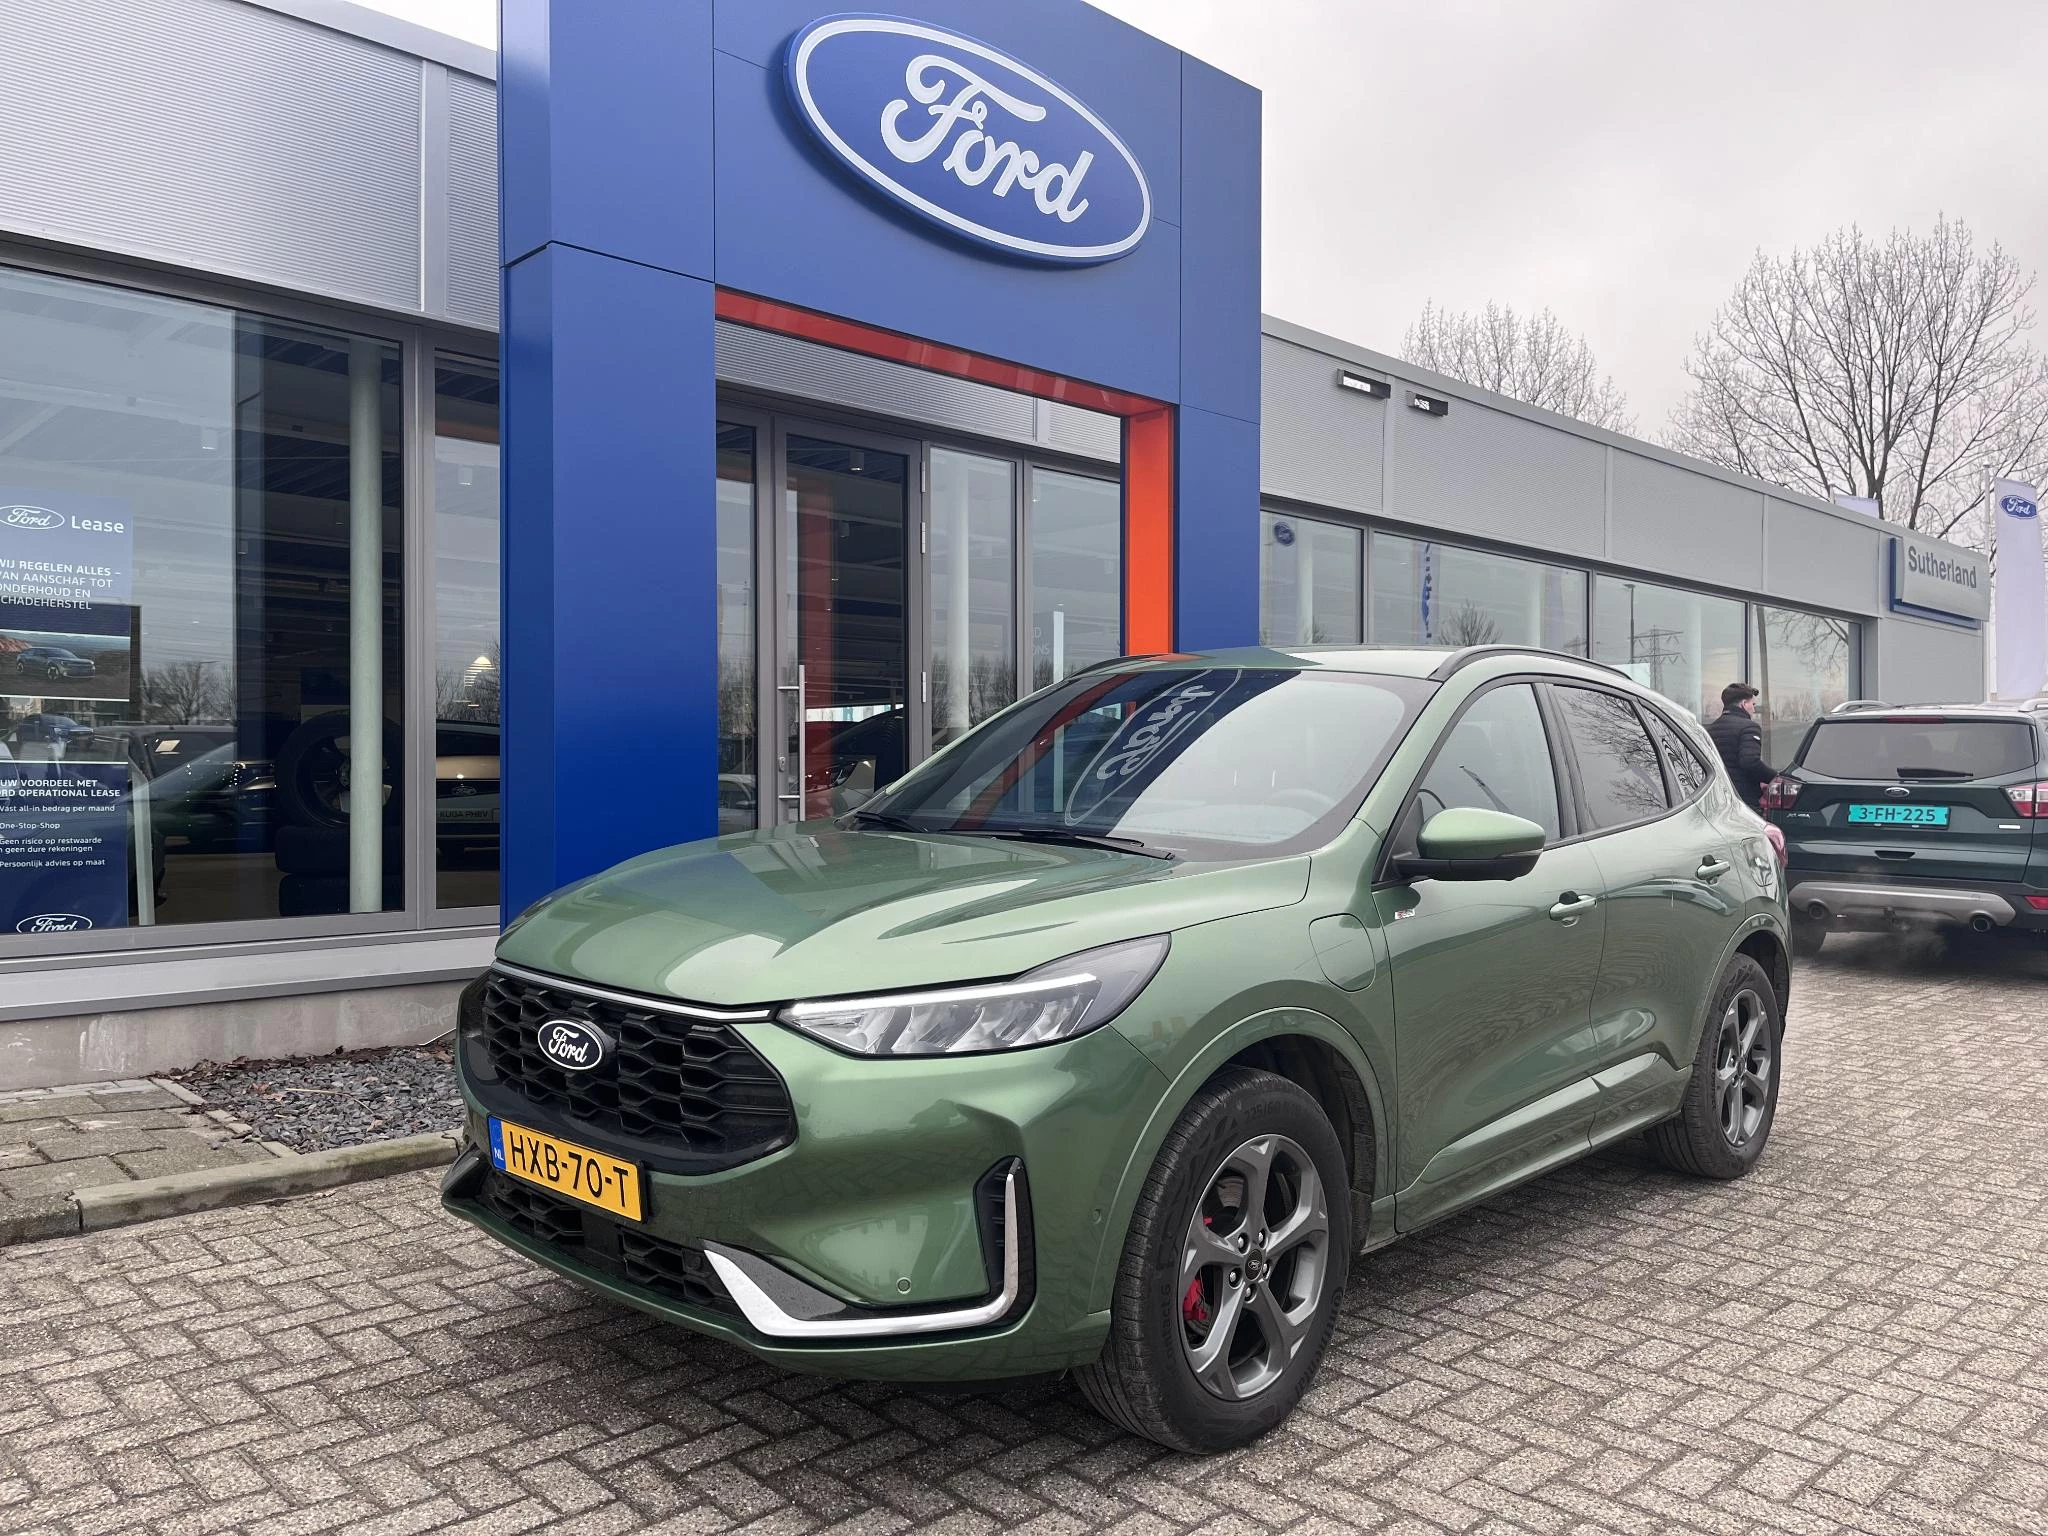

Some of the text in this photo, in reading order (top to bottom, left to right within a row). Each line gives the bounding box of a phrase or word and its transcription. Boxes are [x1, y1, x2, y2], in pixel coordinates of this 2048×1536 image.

[880, 54, 1095, 223] Ford
[2006, 496, 2031, 515] Ford
[7, 507, 125, 534] Ford Lease
[19, 560, 73, 573] REGELEN
[76, 565, 111, 577] ALLES
[1907, 545, 1977, 589] Sutherland
[0, 571, 113, 588] AN AANSCHAF TOT
[75, 588, 91, 598] EN
[21, 779, 74, 787] VOORDEEL
[76, 779, 98, 787] MET
[0, 789, 121, 797] RD OPERATIONAL LEASE
[42, 805, 70, 813] bedrag
[1858, 806, 1936, 822] 3-FH-225
[0, 822, 61, 830] One-Stop-Shop
[5, 846, 25, 855] geen
[48, 846, 93, 854] rekeningen
[547, 1026, 590, 1063] Ford
[493, 1147, 505, 1161] NL
[509, 1130, 629, 1208] HXB-70-T
